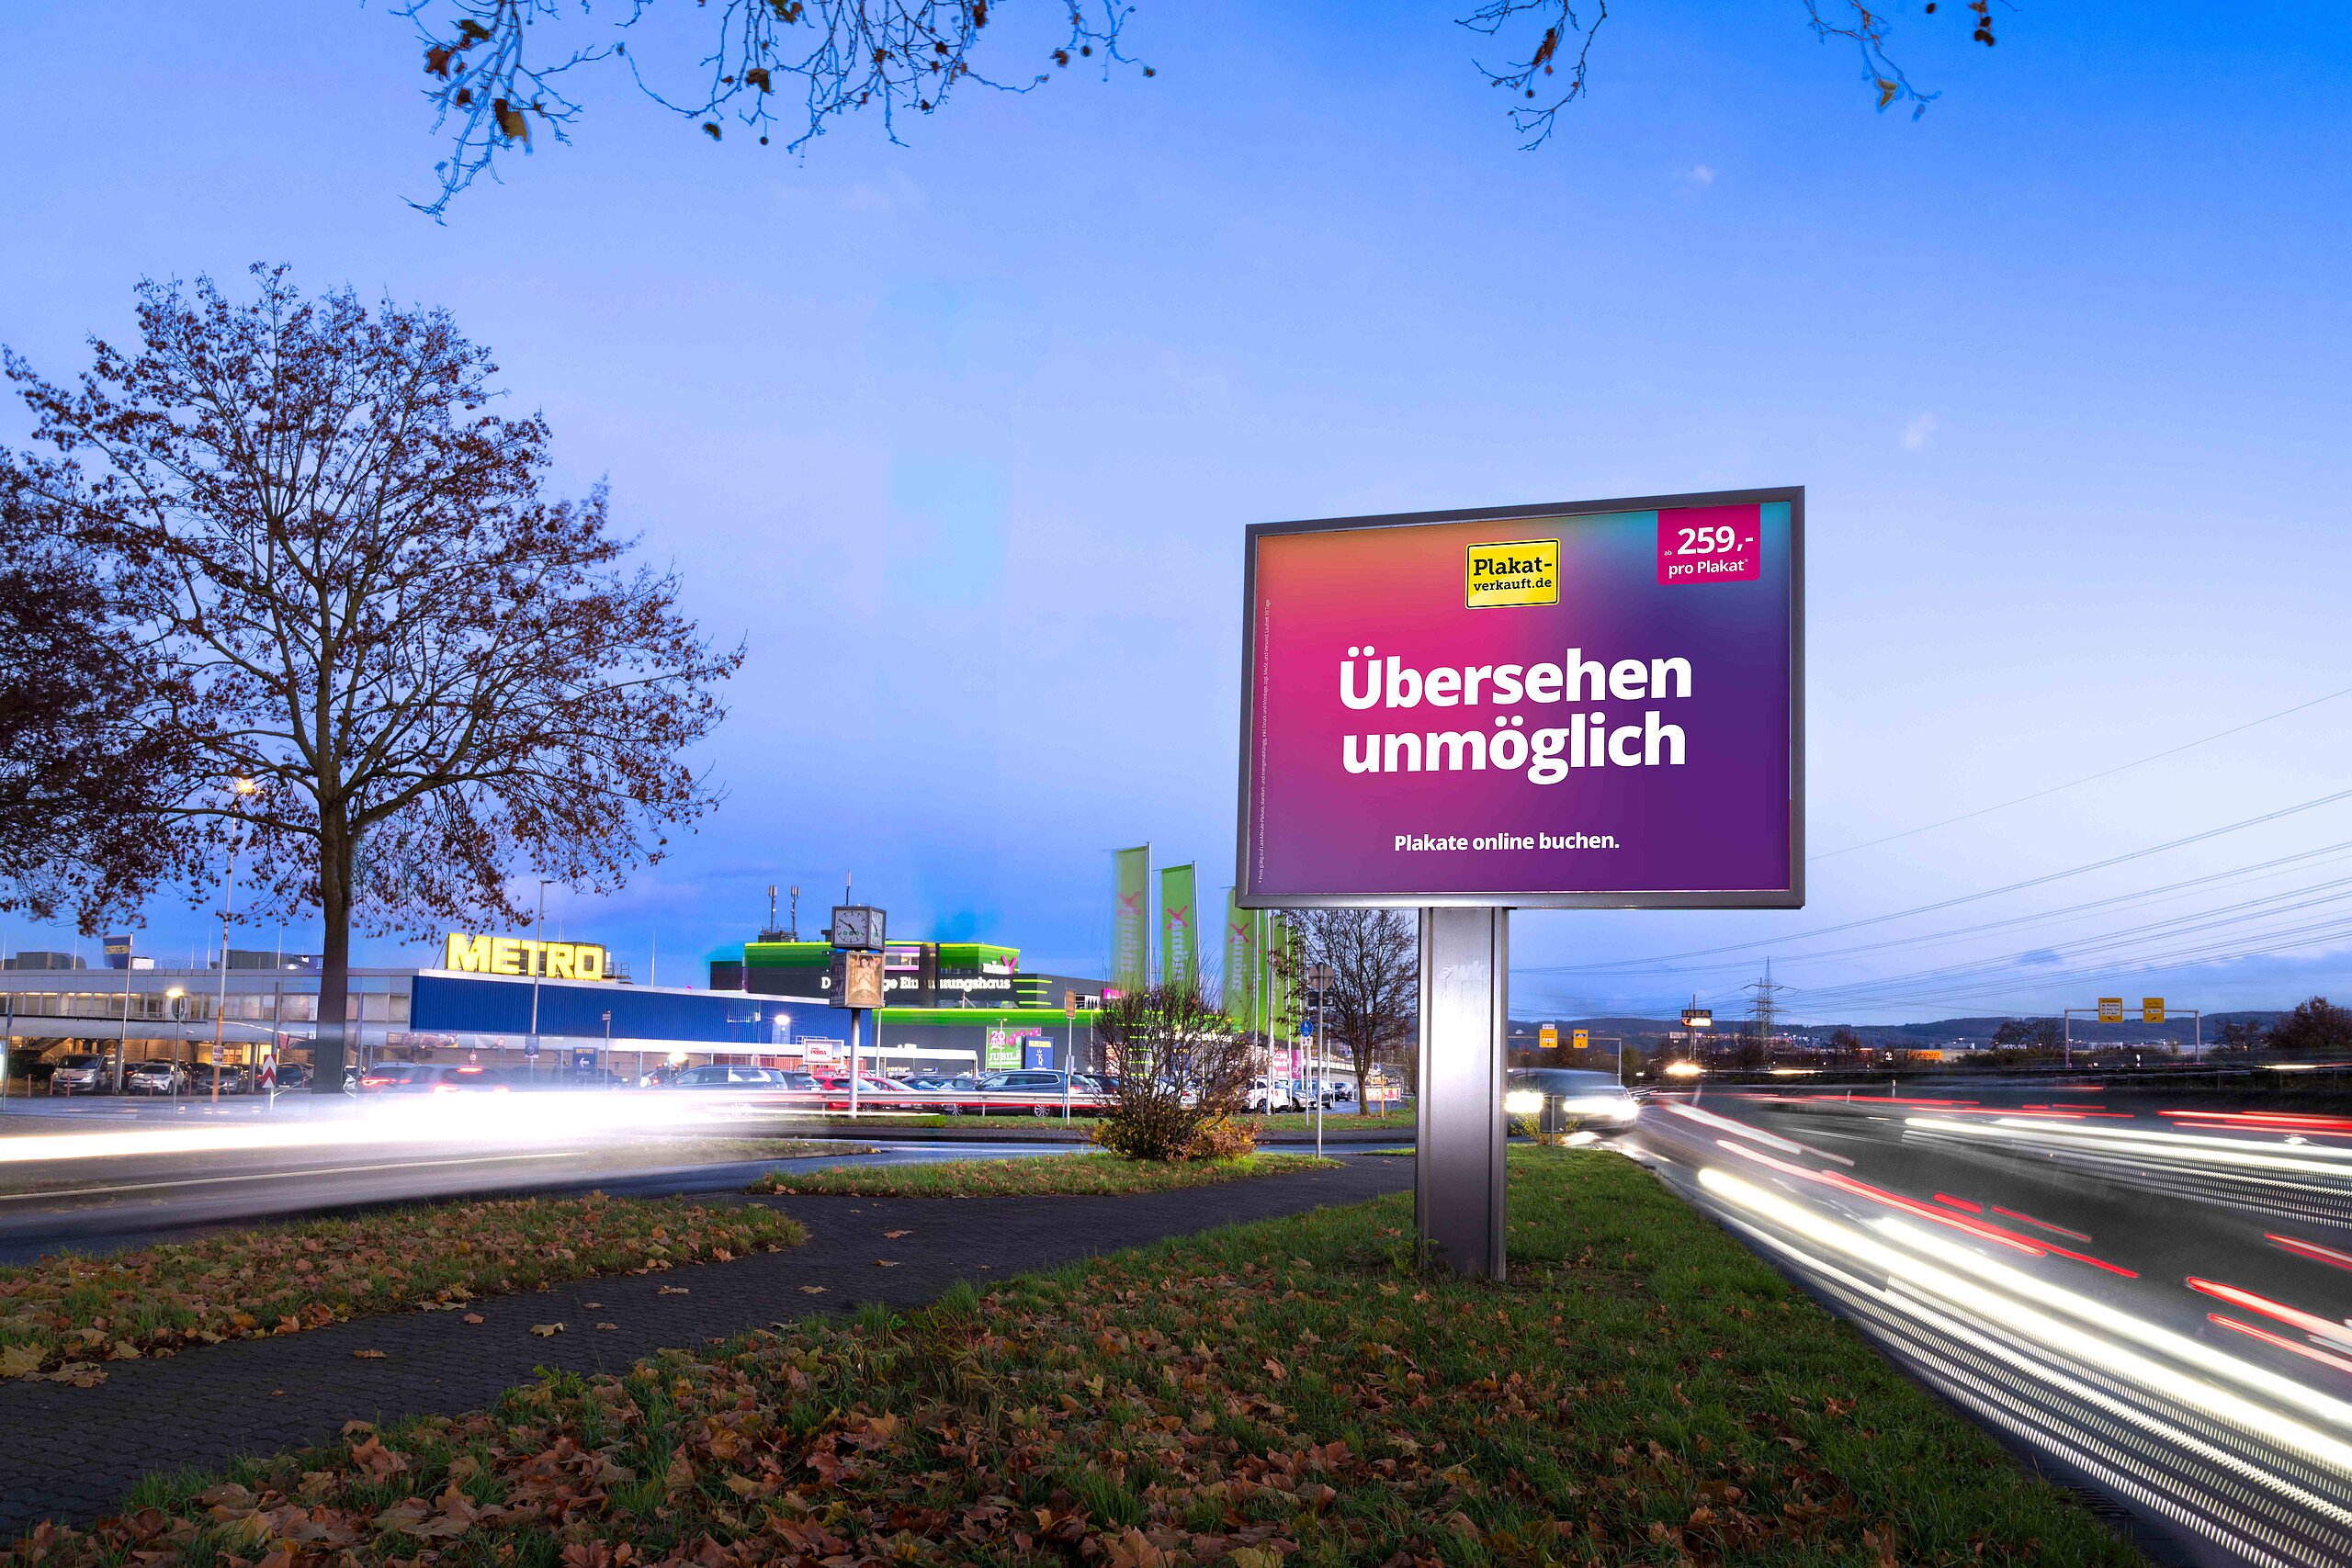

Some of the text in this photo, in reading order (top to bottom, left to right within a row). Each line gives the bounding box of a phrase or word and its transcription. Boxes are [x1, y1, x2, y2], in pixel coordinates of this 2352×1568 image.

[1677, 525, 1754, 556] 259,-
[1473, 557, 1553, 576] Plakat-
[1668, 562, 1694, 579] pro
[1473, 577, 1553, 592] verkauft.de
[1340, 645, 1692, 710] Übersehen
[1342, 710, 1686, 785] unmöglich
[1395, 831, 1620, 852] Plakate online buchen.
[446, 931, 604, 981] METRO
[990, 1031, 1006, 1041] 20
